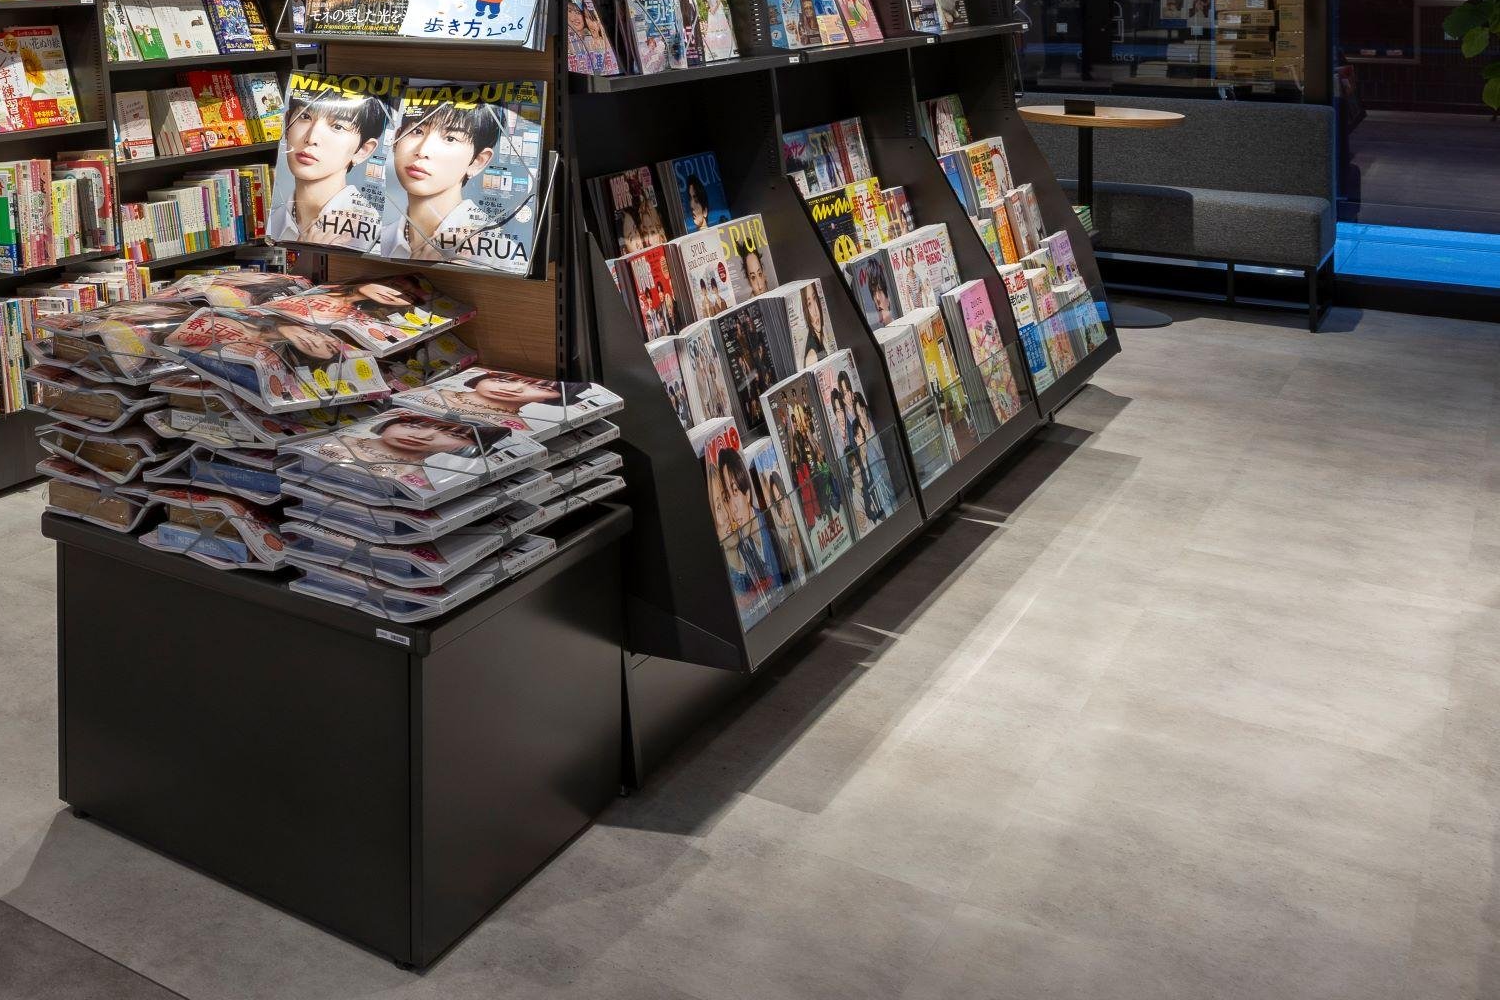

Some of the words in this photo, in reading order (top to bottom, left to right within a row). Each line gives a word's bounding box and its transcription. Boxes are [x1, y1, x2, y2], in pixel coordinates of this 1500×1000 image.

[309, 8, 407, 24] モネの愛した光を
[423, 18, 483, 38] 歩き方
[486, 16, 524, 37] 2026
[674, 153, 722, 194] SPUR
[440, 232, 529, 262] HARUA
[690, 241, 708, 258] SPUR
[716, 218, 769, 261] SPUR
